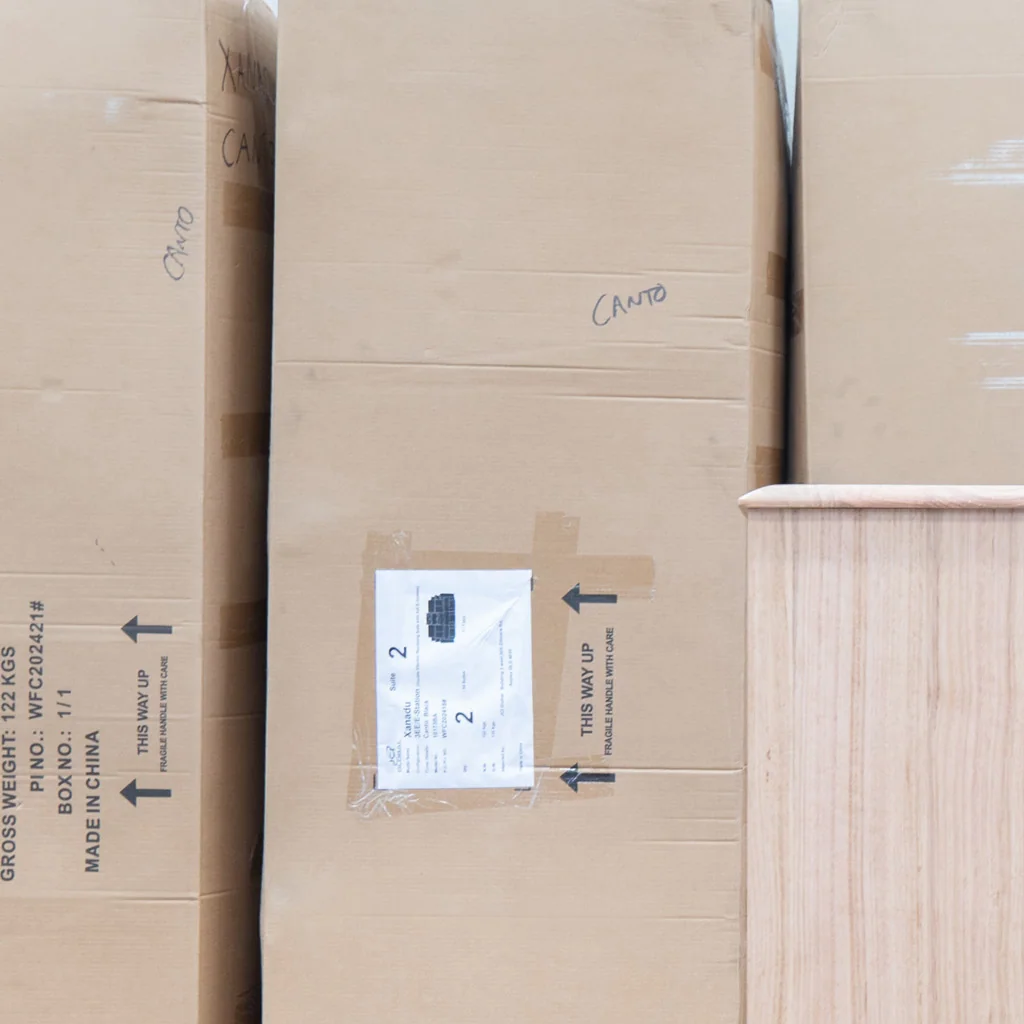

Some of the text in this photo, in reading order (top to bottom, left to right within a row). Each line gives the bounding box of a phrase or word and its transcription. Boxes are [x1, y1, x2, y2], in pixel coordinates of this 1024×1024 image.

[592, 283, 668, 328] CANTO
[389, 647, 406, 658] 2
[606, 628, 614, 652] CARE
[29, 601, 44, 791] PI NO.: WFC202421#
[581, 643, 593, 736] THIS WAY UP
[605, 679, 613, 715] HANDLE
[137, 670, 149, 755] THIS WAY UP
[455, 712, 473, 723] 2
[58, 732, 71, 769] NO.:
[604, 718, 613, 755] FRAGILE
[0, 647, 16, 881] GROSS WEIGHT: 122 KGS
[58, 775, 72, 814] BOX
[85, 731, 100, 872] MADE IN CHINA
